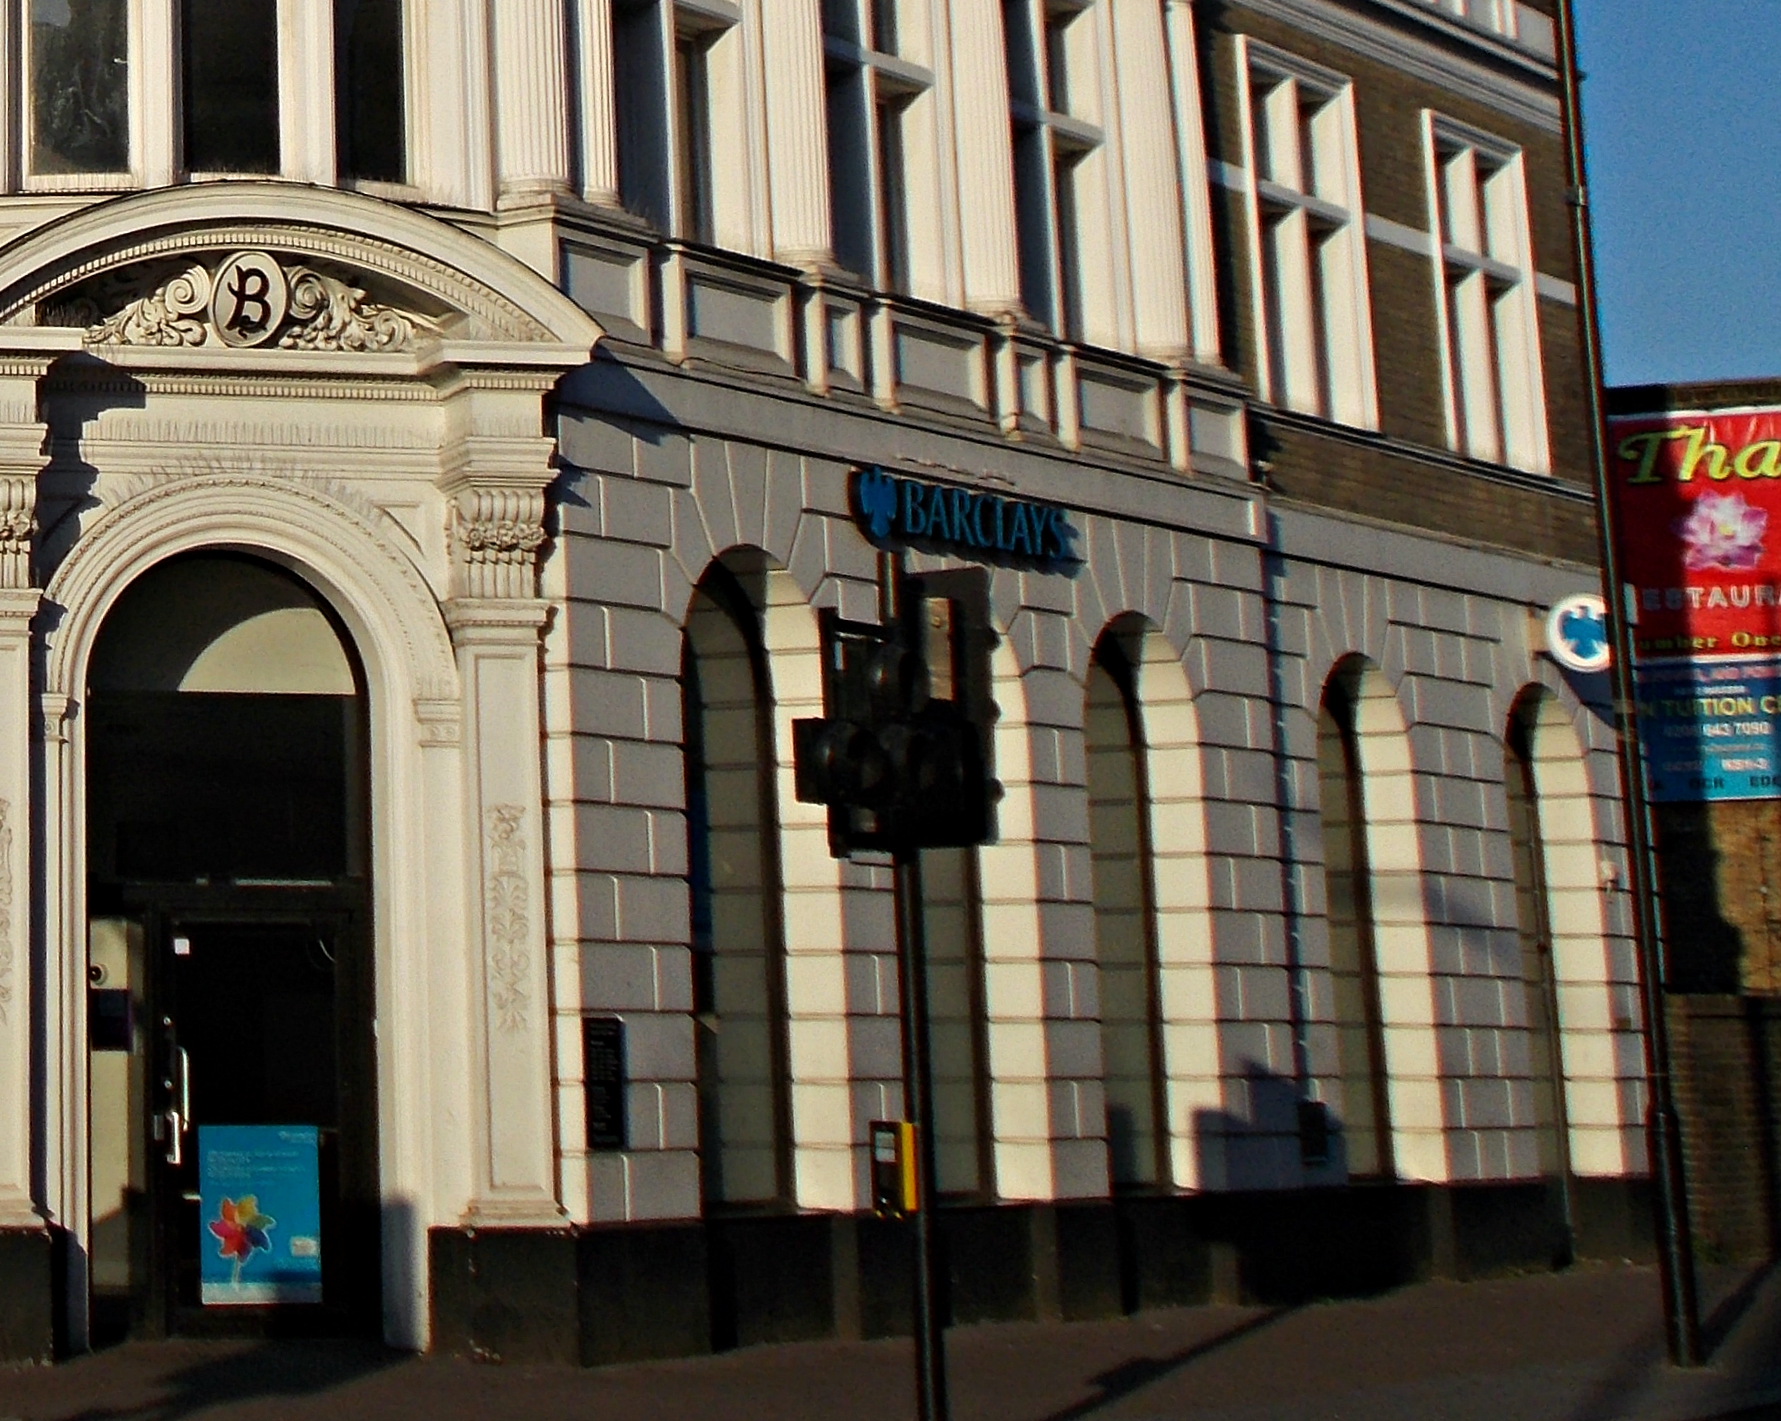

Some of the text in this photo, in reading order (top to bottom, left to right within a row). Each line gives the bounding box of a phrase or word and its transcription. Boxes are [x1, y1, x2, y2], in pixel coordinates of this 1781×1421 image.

[227, 264, 272, 339] B
[903, 481, 1071, 561] BARCLAYS
[1662, 697, 1756, 716] TUITION
